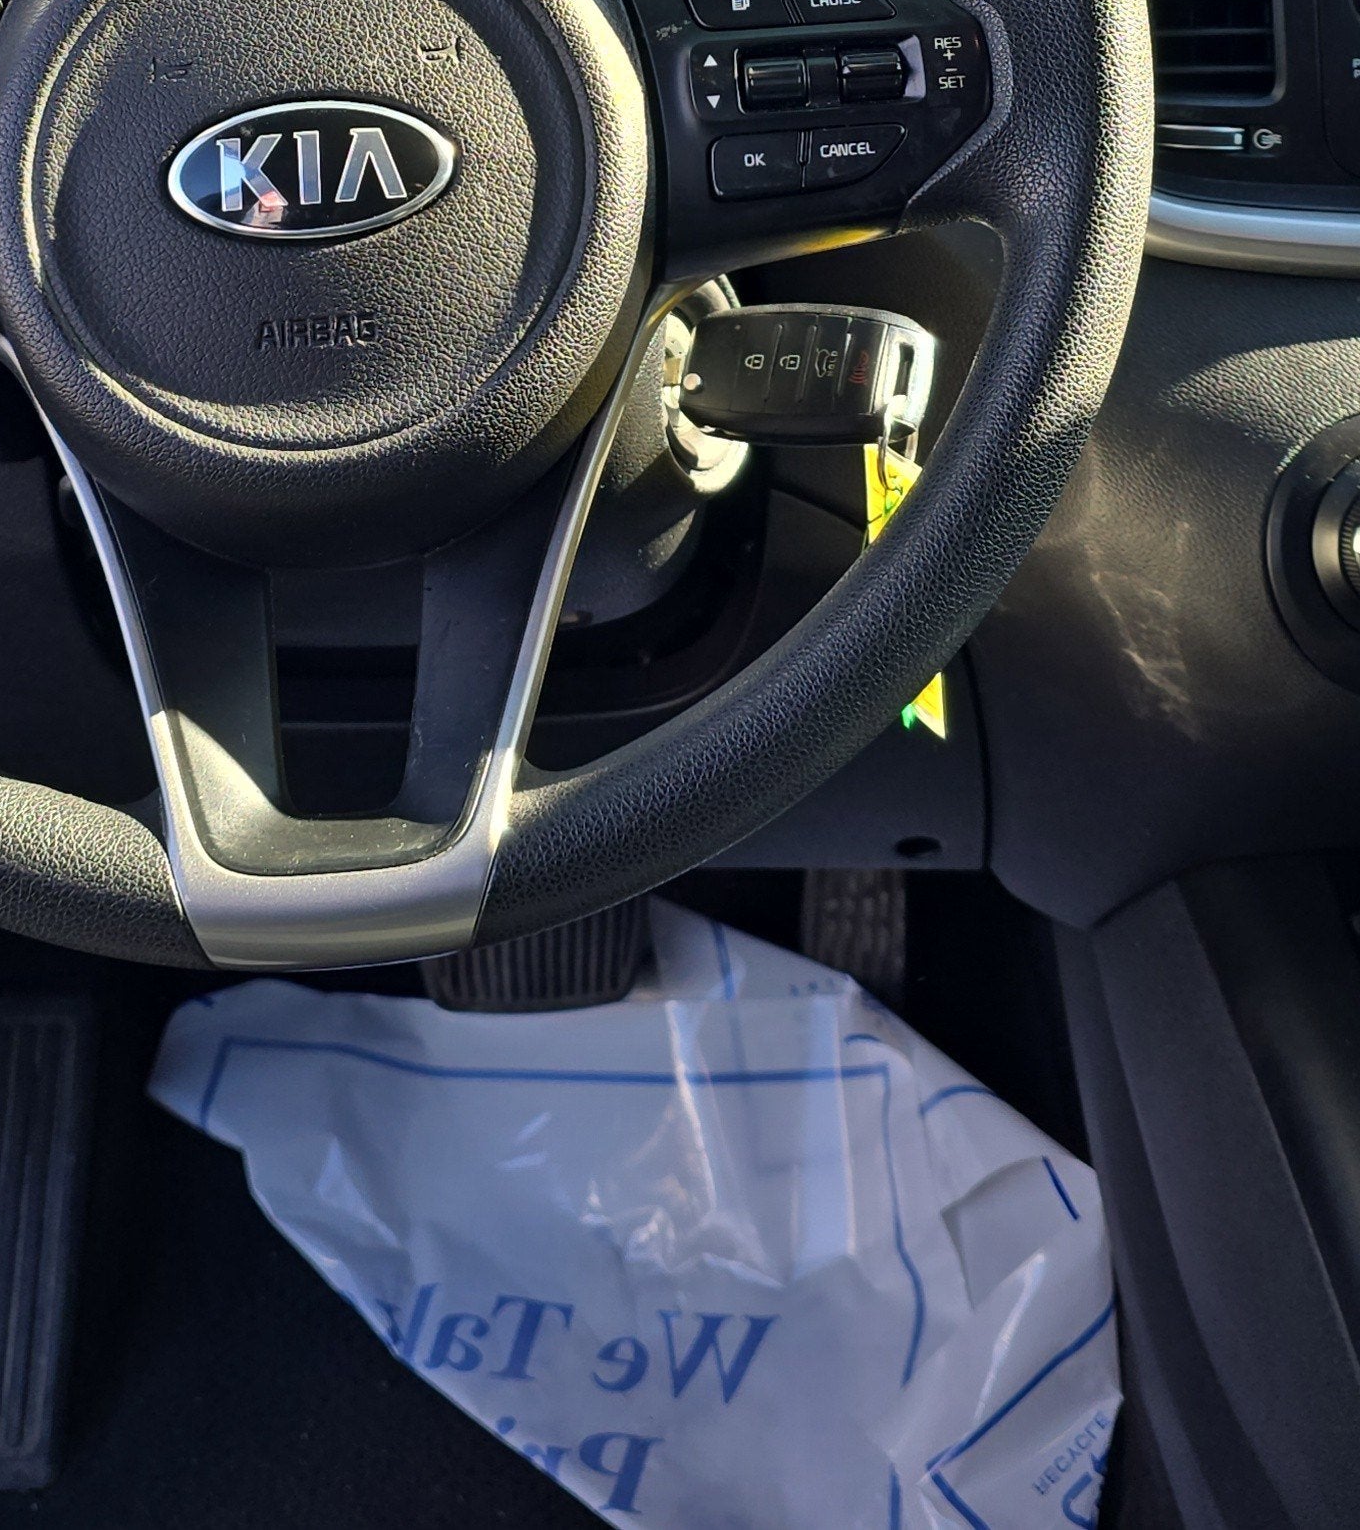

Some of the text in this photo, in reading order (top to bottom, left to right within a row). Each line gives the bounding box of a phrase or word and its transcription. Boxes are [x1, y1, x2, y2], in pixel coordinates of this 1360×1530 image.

[934, 36, 962, 50] RES
[938, 75, 967, 89] SET
[820, 142, 876, 158] CANCEL
[744, 153, 767, 168] OK
[216, 127, 408, 212] KIA
[257, 312, 381, 351] AIRBAG
